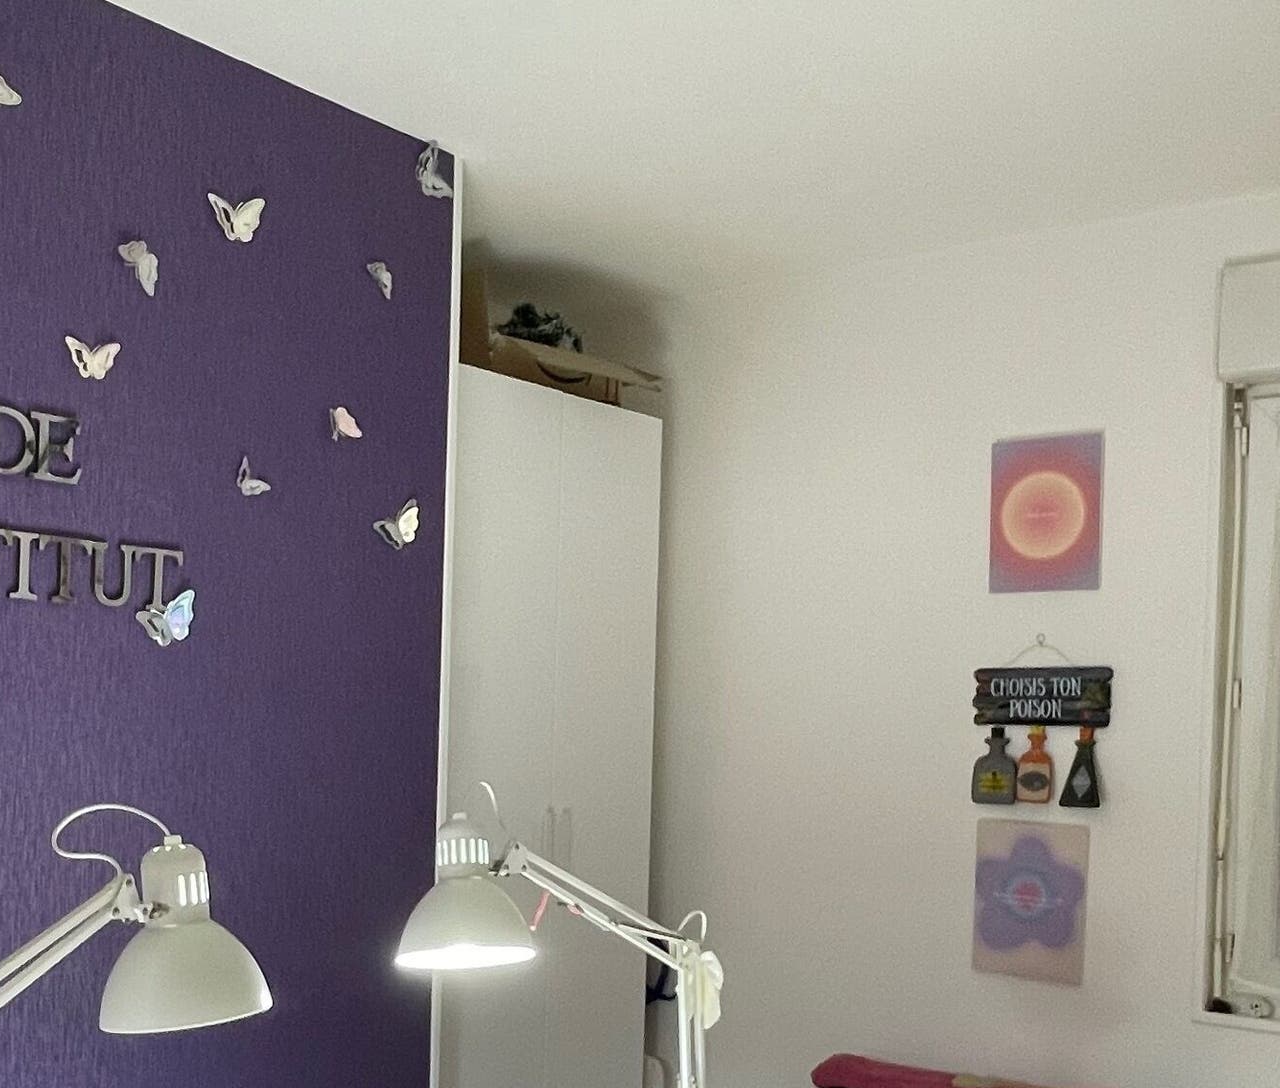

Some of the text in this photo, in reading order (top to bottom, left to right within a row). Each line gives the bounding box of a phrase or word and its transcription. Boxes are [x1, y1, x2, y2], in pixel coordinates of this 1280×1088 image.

[990, 677, 1081, 697] CHOISIS TON
[1009, 699, 1062, 718] POISON
